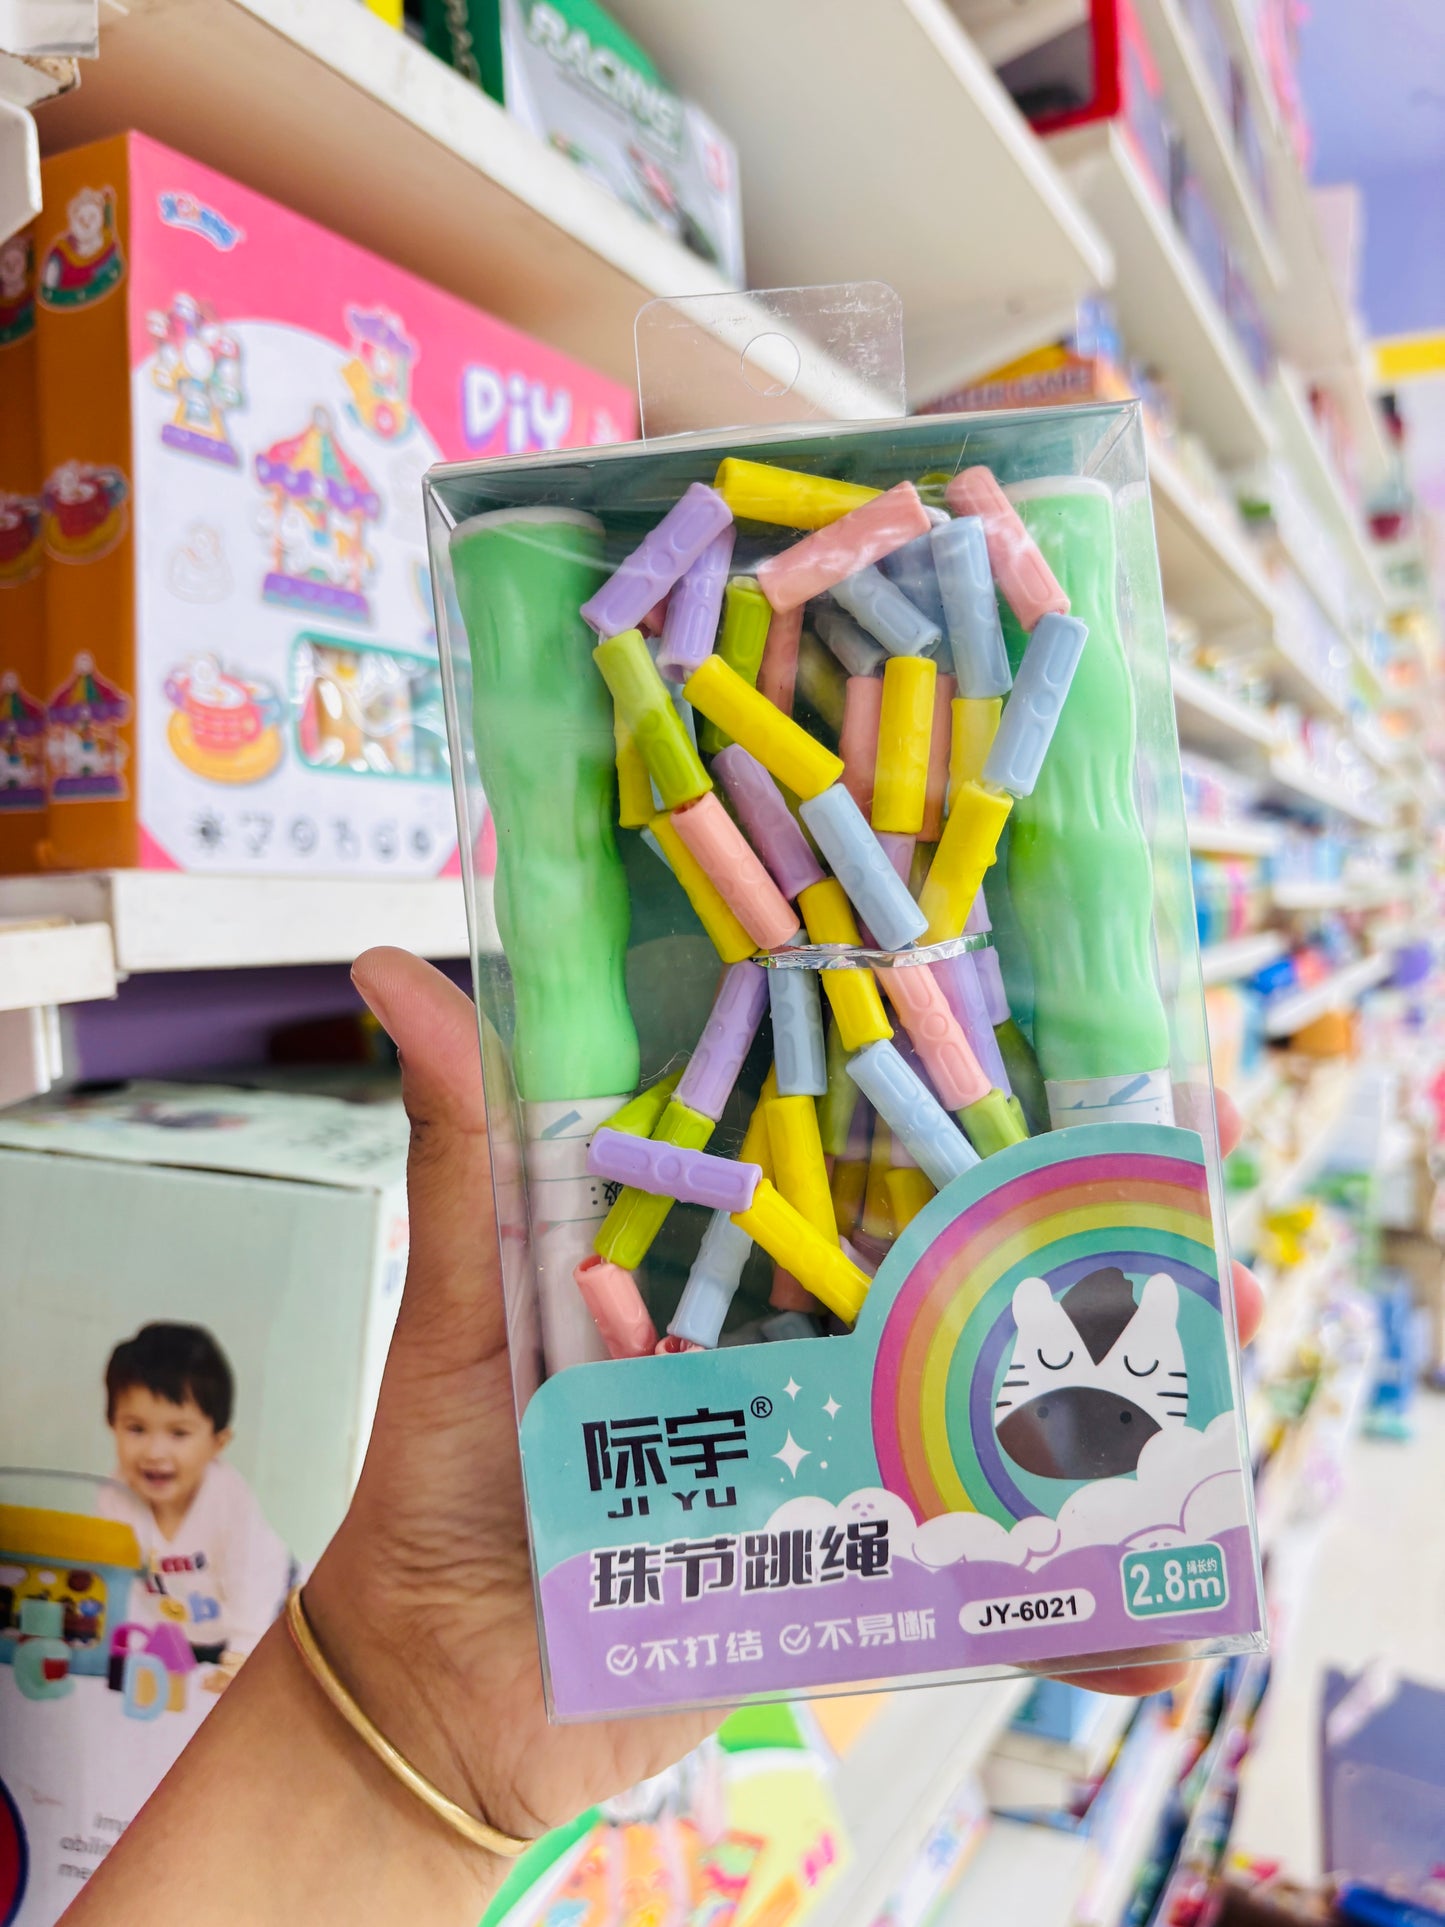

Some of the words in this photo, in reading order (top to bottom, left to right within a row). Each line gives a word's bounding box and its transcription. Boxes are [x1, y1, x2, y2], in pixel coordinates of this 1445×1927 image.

[581, 1407, 749, 1491] 际宇
[590, 1517, 892, 1611] 珠节跳绳
[1130, 1559, 1222, 1607] 2.8m
[814, 1607, 936, 1651] 不易断
[978, 1594, 1078, 1628] JY-6021
[640, 1629, 765, 1672] 不打结
